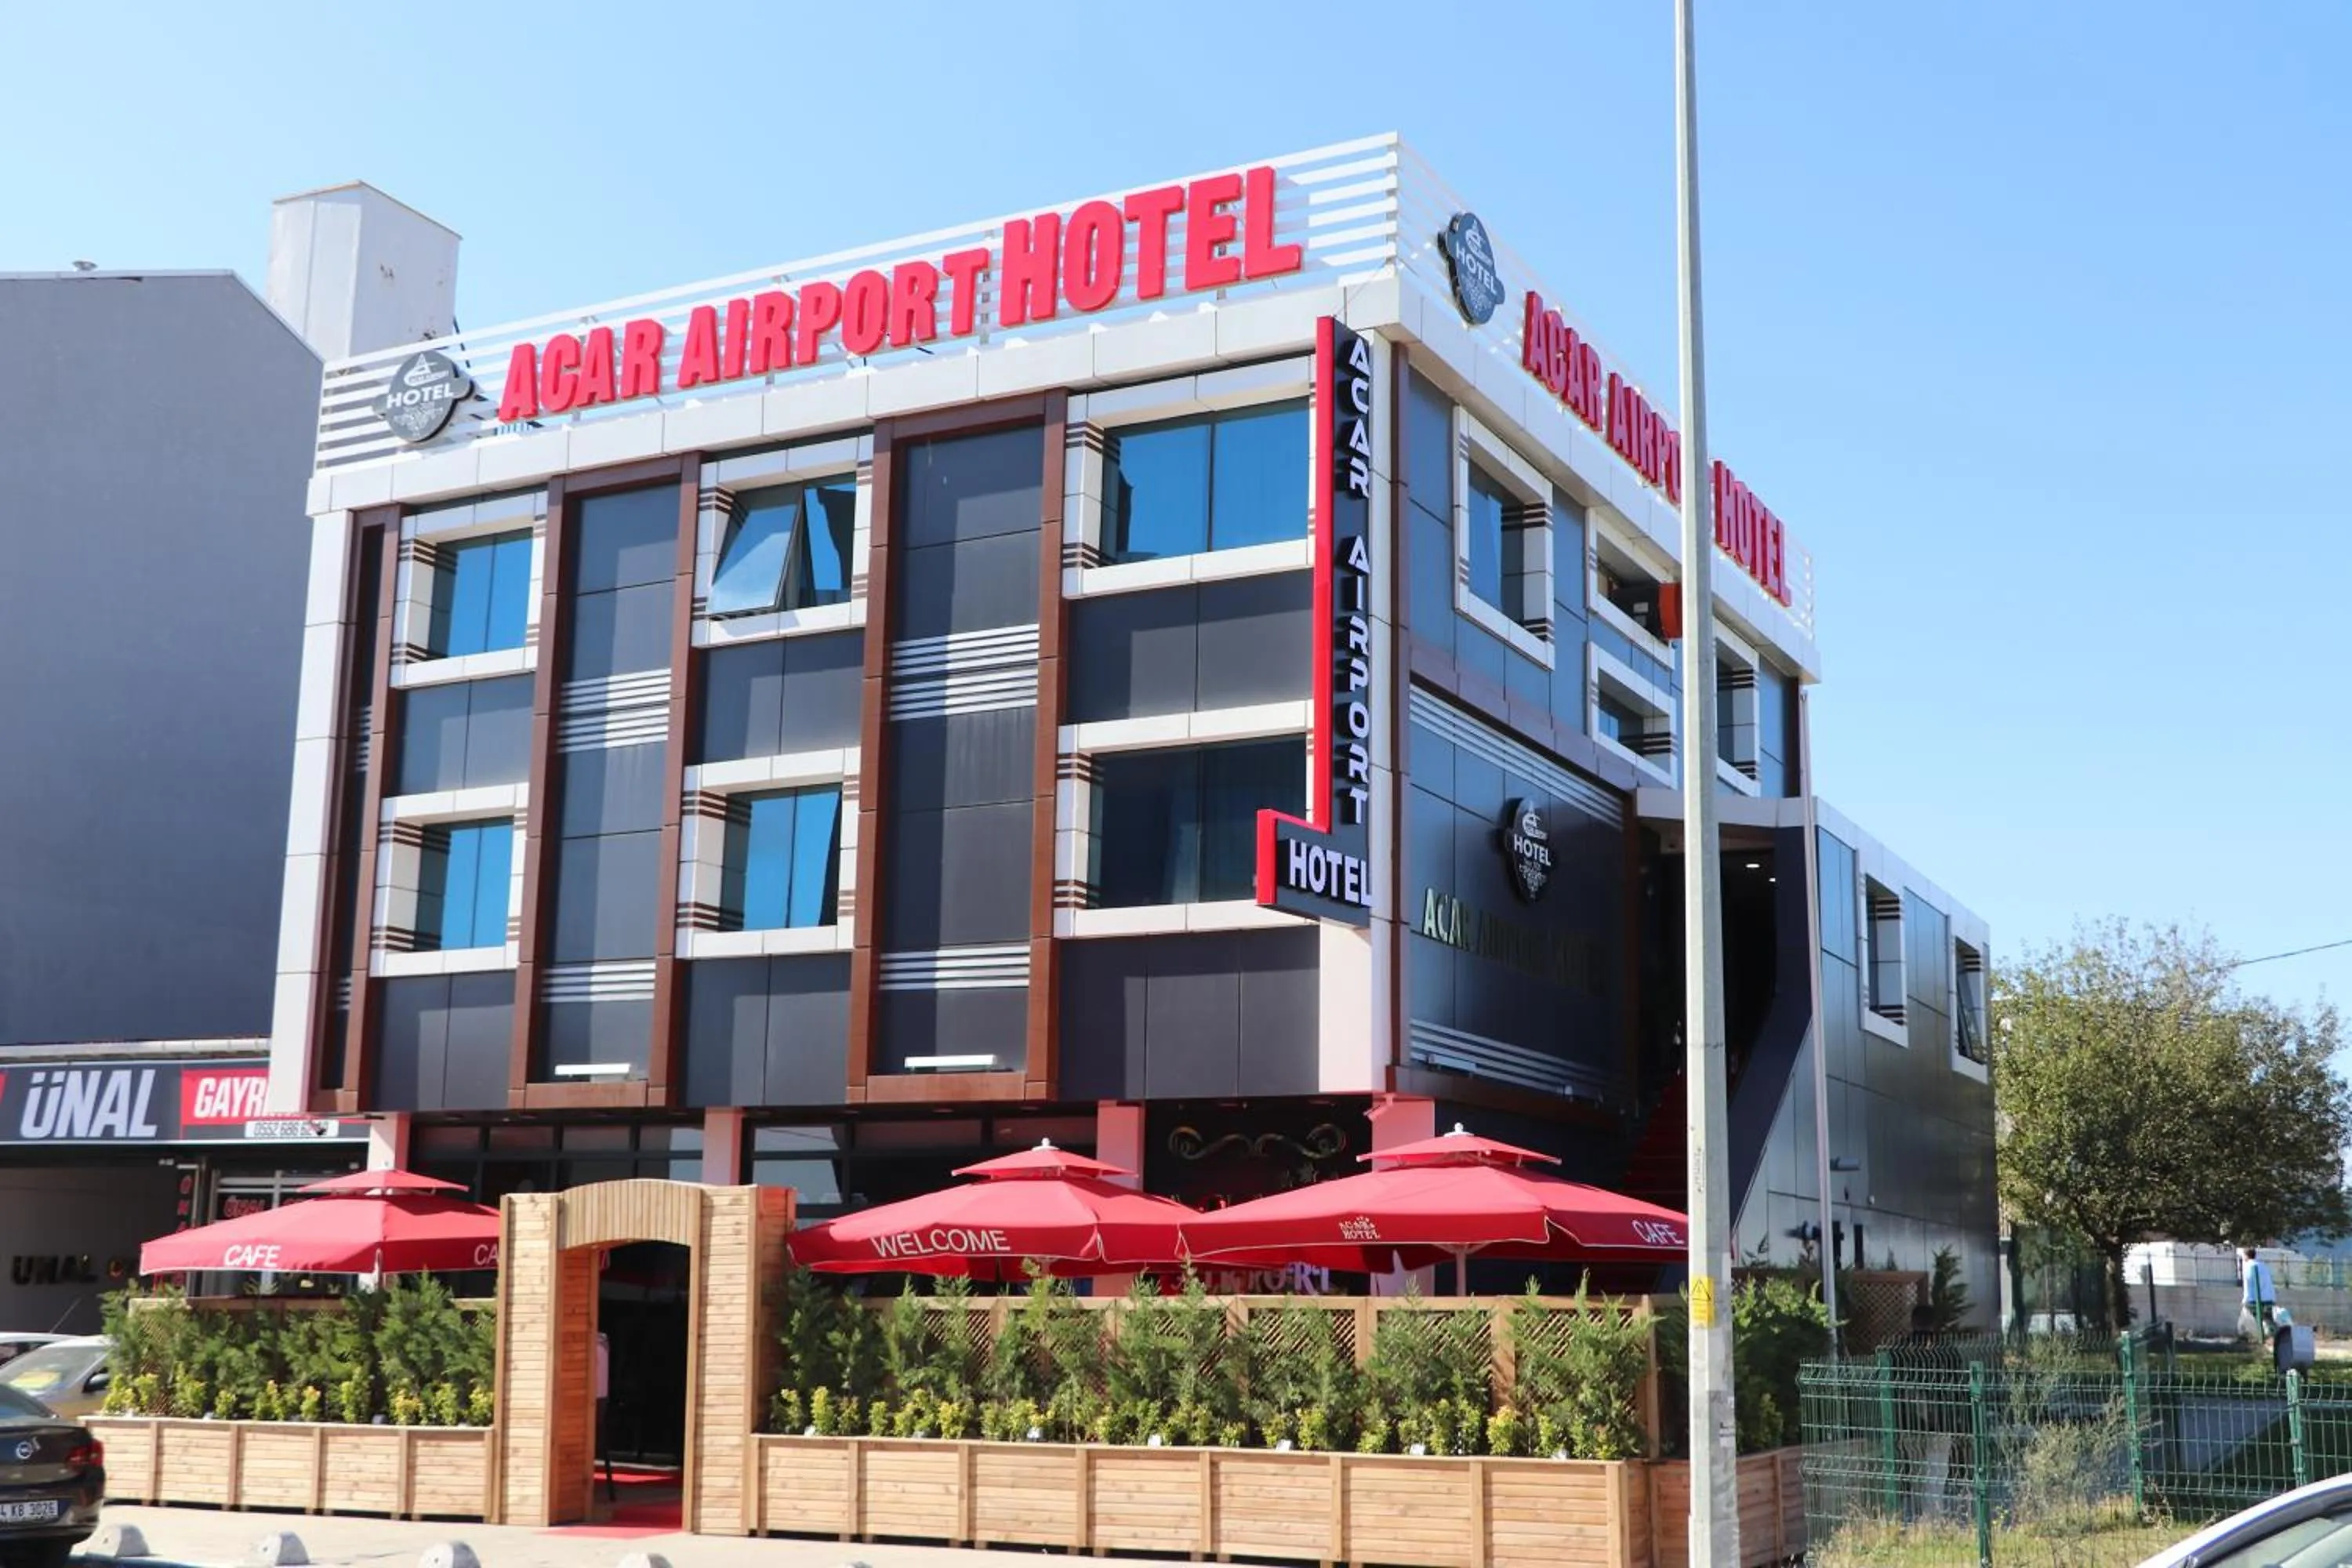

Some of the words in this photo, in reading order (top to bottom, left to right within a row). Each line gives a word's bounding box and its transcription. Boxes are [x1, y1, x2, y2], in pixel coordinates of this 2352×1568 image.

[497, 318, 664, 424] ACAR
[677, 247, 989, 389] AIRPORT
[1000, 165, 1302, 328] HOTEL
[1456, 241, 1497, 296] HOTEL
[387, 382, 454, 409] HOTEL
[1348, 337, 1371, 499] ACAR
[1522, 291, 1602, 433] ACAR
[1606, 372, 1712, 510] AIRPO
[1713, 459, 1791, 608] HOTEL
[1348, 534, 1371, 825] AIRPORT
[1288, 838, 1374, 908] HOTEL
[1513, 833, 1552, 866] HOTEL
[20, 1069, 158, 1139] ÜNAL
[193, 1076, 269, 1120] GAYR
[223, 1244, 281, 1269] CAFE
[474, 1243, 499, 1266] CA
[871, 1229, 1011, 1258] WELCOME
[1632, 1220, 1684, 1245] CAFE
